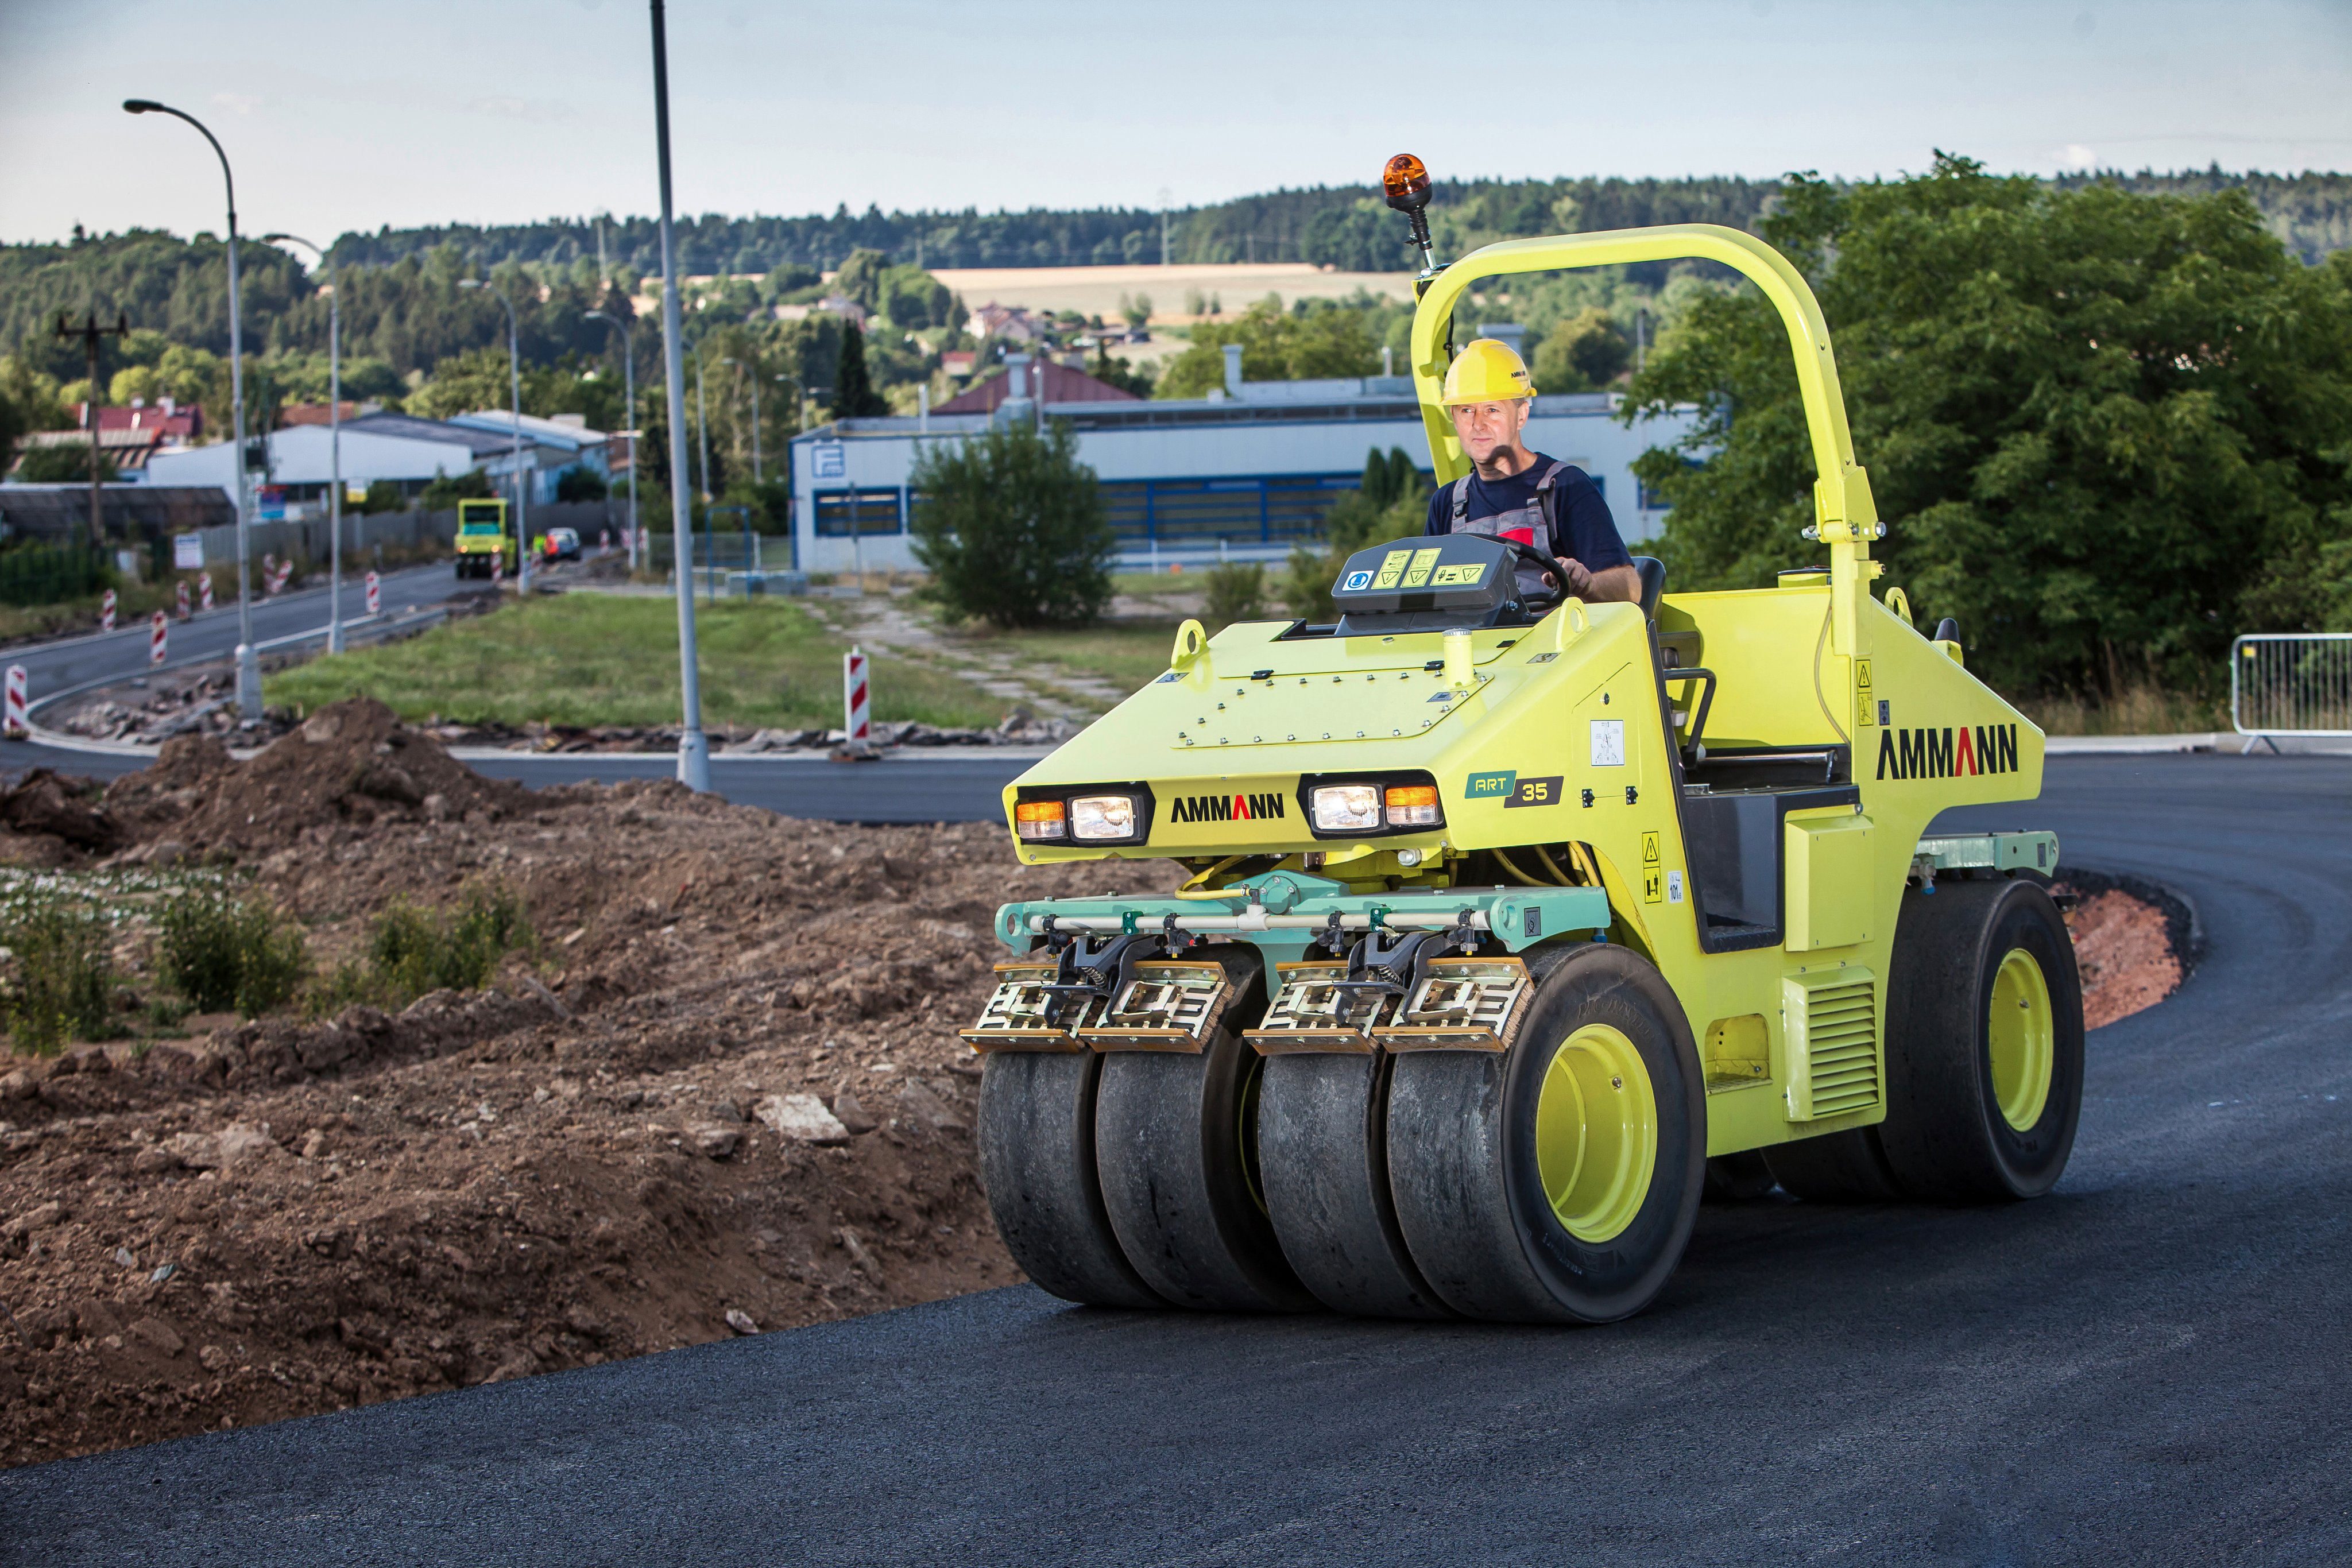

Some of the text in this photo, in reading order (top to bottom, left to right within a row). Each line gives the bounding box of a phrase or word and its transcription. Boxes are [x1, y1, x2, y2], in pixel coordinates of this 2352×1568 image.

[1877, 723, 2018, 780] AMMANN
[1475, 777, 1548, 802] ART 35
[1171, 793, 1285, 823] AMMANN
[1670, 884, 1678, 900] 101
